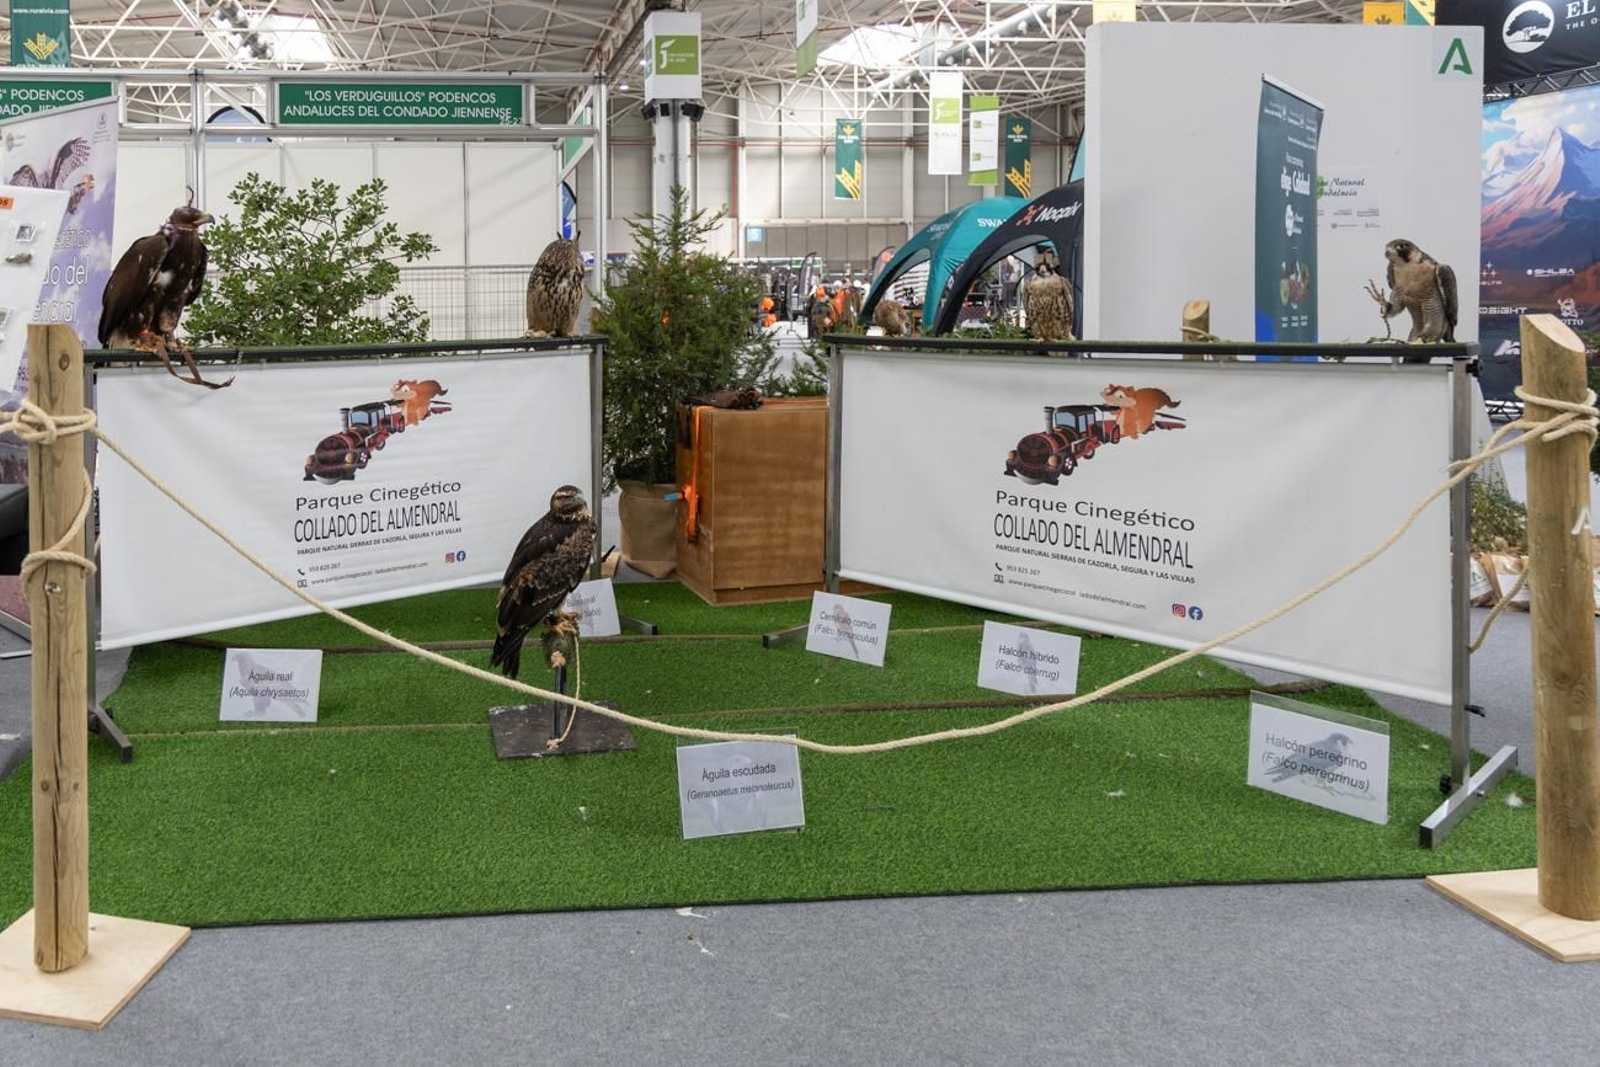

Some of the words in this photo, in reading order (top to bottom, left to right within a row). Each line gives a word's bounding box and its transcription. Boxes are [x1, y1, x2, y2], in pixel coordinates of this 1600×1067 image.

[1565, 0, 1596, 19] EL
[10, 89, 85, 102] PODENCOS
[304, 90, 332, 102] "LOS
[334, 90, 426, 103] VERDUGUILLOS"
[428, 92, 496, 104] PODENCOS
[284, 105, 355, 117] ANDALUCES
[358, 105, 380, 117] DEL
[383, 106, 448, 118] CONDADO
[451, 106, 512, 119] JIENNENSE
[64, 256, 88, 286] del
[296, 492, 364, 512] Parque
[369, 481, 461, 501] Cinegético
[294, 513, 358, 543] COLLADO
[361, 506, 385, 534] DEL
[386, 500, 461, 531] ALMENDRAL
[996, 490, 1068, 513] Parque
[1074, 500, 1195, 532] Cinegético
[297, 546, 321, 556] PARQUE
[322, 543, 349, 553] NATURAL
[350, 539, 373, 548] SIERRAS
[409, 532, 430, 542] SEGURA
[435, 529, 445, 537] LAS
[444, 527, 462, 535] VILLAS
[993, 512, 1059, 546] COLLADO
[1063, 523, 1090, 551] DEL
[1093, 529, 1194, 569] ALMENDRAL
[995, 543, 1020, 554] PARQUE
[1021, 548, 1050, 559] NATURAL
[1051, 553, 1076, 563] SIERRAS
[1077, 557, 1086, 565] DE
[1087, 559, 1120, 571] CAZORLA,
[1120, 565, 1148, 576] SEGURA
[1156, 571, 1169, 580] LAS
[1170, 574, 1195, 584] VILLAS
[852, 619, 877, 631] común
[998, 644, 1028, 659] Halcón
[276, 671, 293, 682] real
[995, 659, 1022, 673] (Falco
[1265, 732, 1306, 754] Halcón
[1308, 746, 1368, 770] peregrino
[732, 763, 776, 778] escudada
[1261, 750, 1298, 770] (Falco
[1299, 763, 1371, 793] peregrinus)
